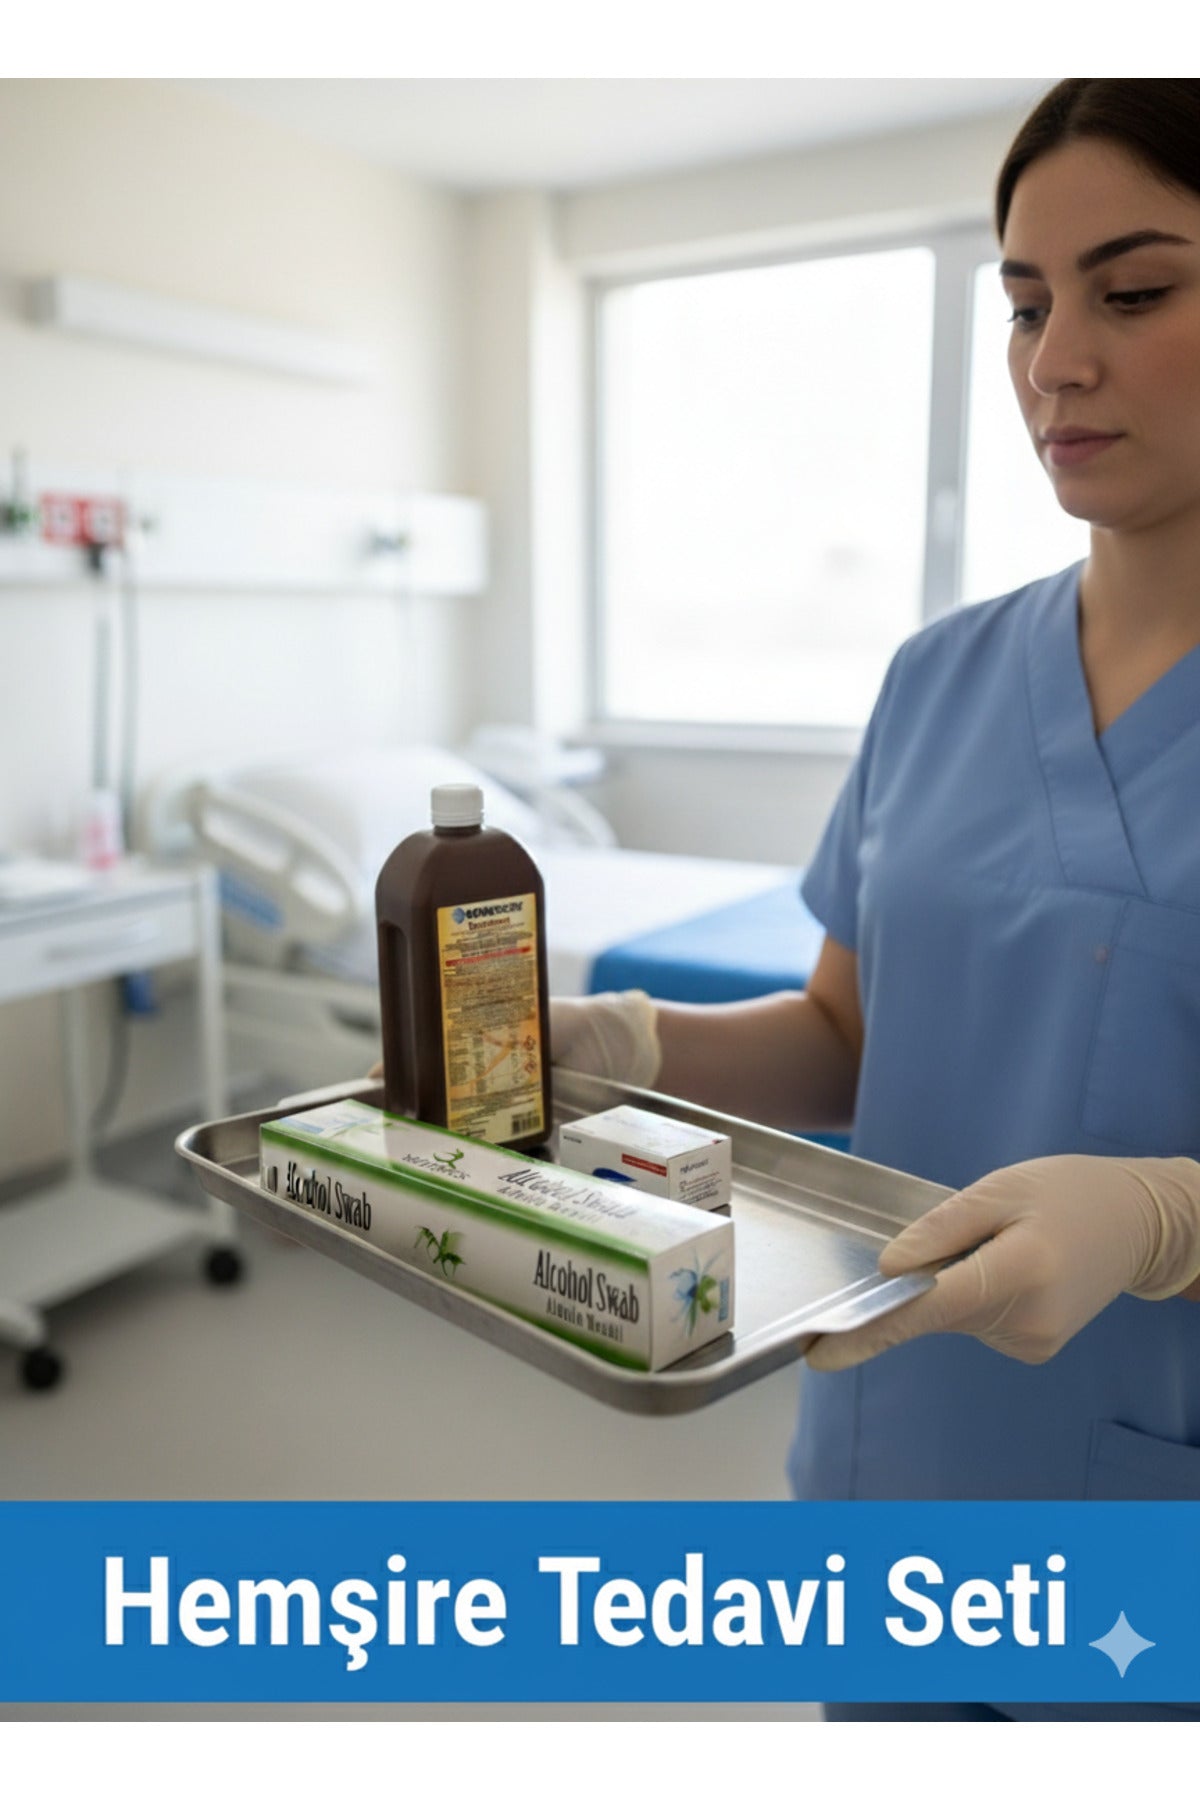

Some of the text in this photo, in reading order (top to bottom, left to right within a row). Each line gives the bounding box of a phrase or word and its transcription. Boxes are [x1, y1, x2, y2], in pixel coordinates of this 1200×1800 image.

[335, 1180, 371, 1231] Swab
[533, 1249, 593, 1309] Alcohol
[595, 1272, 639, 1324] Swab
